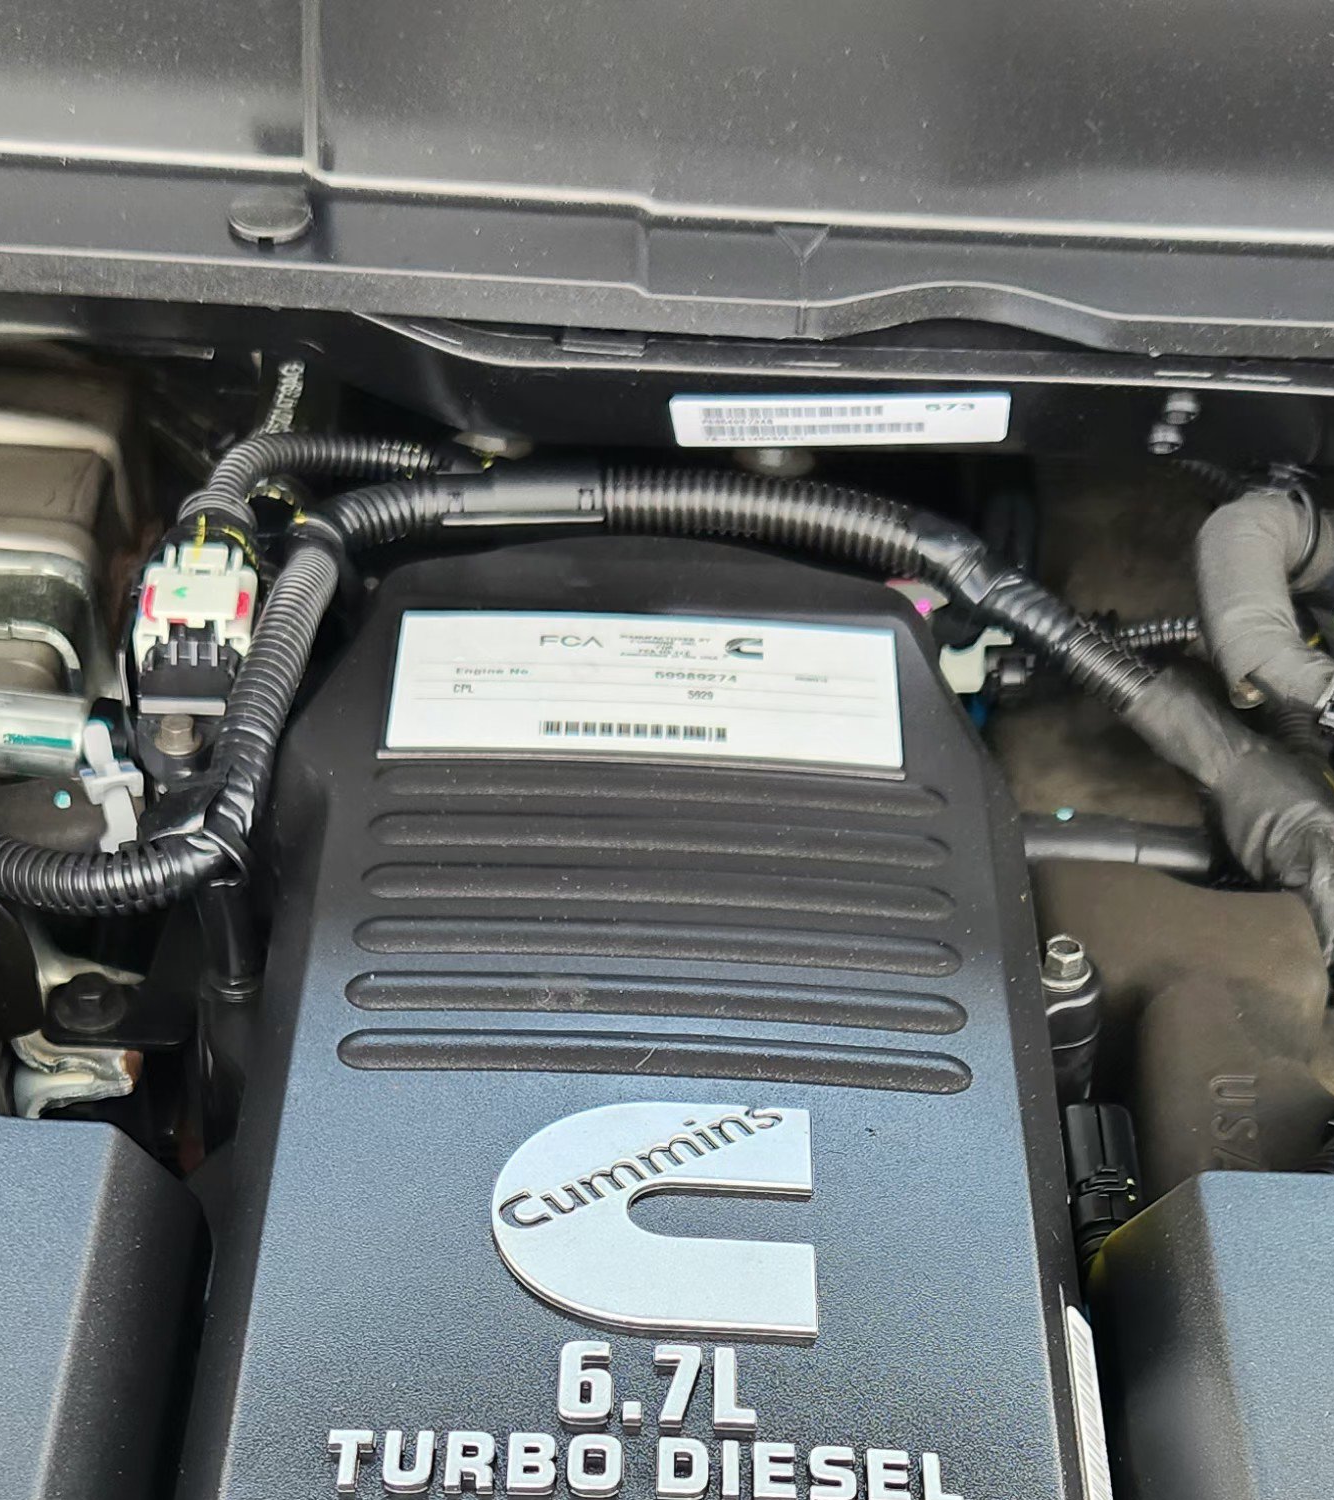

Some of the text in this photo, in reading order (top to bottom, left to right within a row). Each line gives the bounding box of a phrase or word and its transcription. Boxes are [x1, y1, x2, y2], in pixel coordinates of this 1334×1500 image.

[539, 634, 604, 648] FCA
[498, 1105, 784, 1228] Cummins
[556, 1339, 758, 1431] 6.7L
[327, 1428, 625, 1499] TURBO
